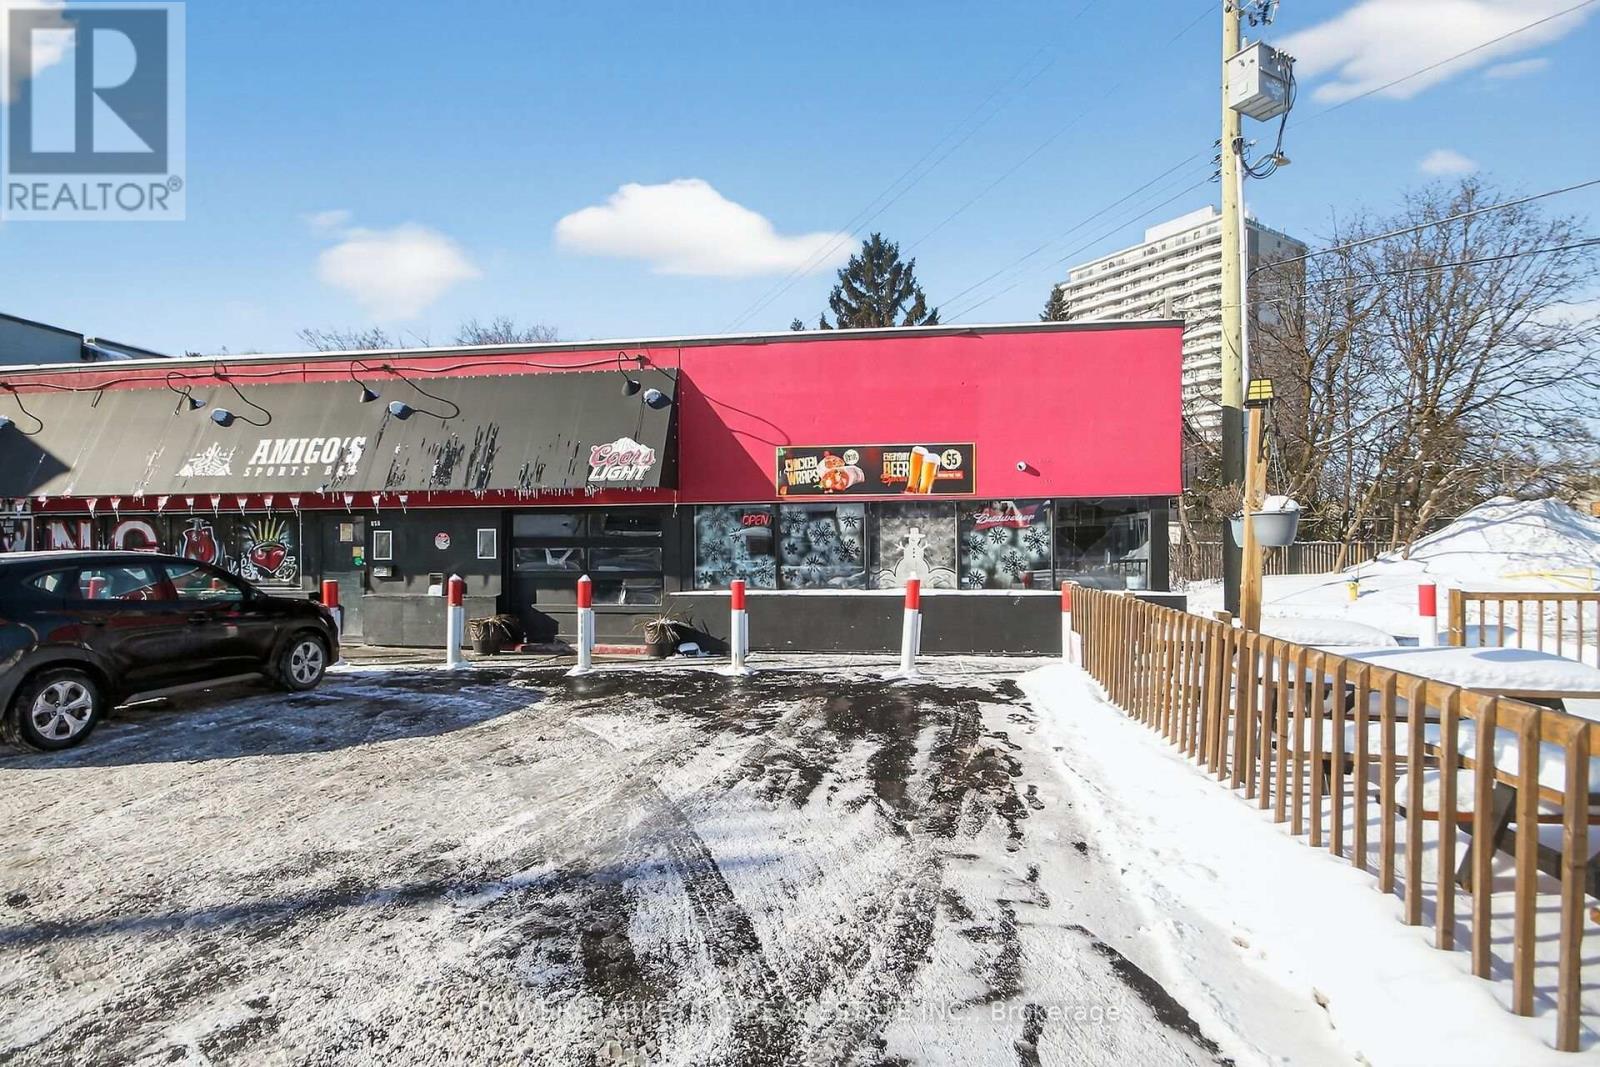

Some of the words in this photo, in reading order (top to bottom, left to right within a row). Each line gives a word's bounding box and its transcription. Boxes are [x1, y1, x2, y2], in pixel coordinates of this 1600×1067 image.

[248, 436, 367, 465] AMIGO'S
[590, 443, 656, 467] Coors
[243, 466, 311, 477] SPORTS
[588, 465, 651, 481] LIGHT
[882, 461, 909, 477] BEER
[742, 514, 769, 526] OPEN
